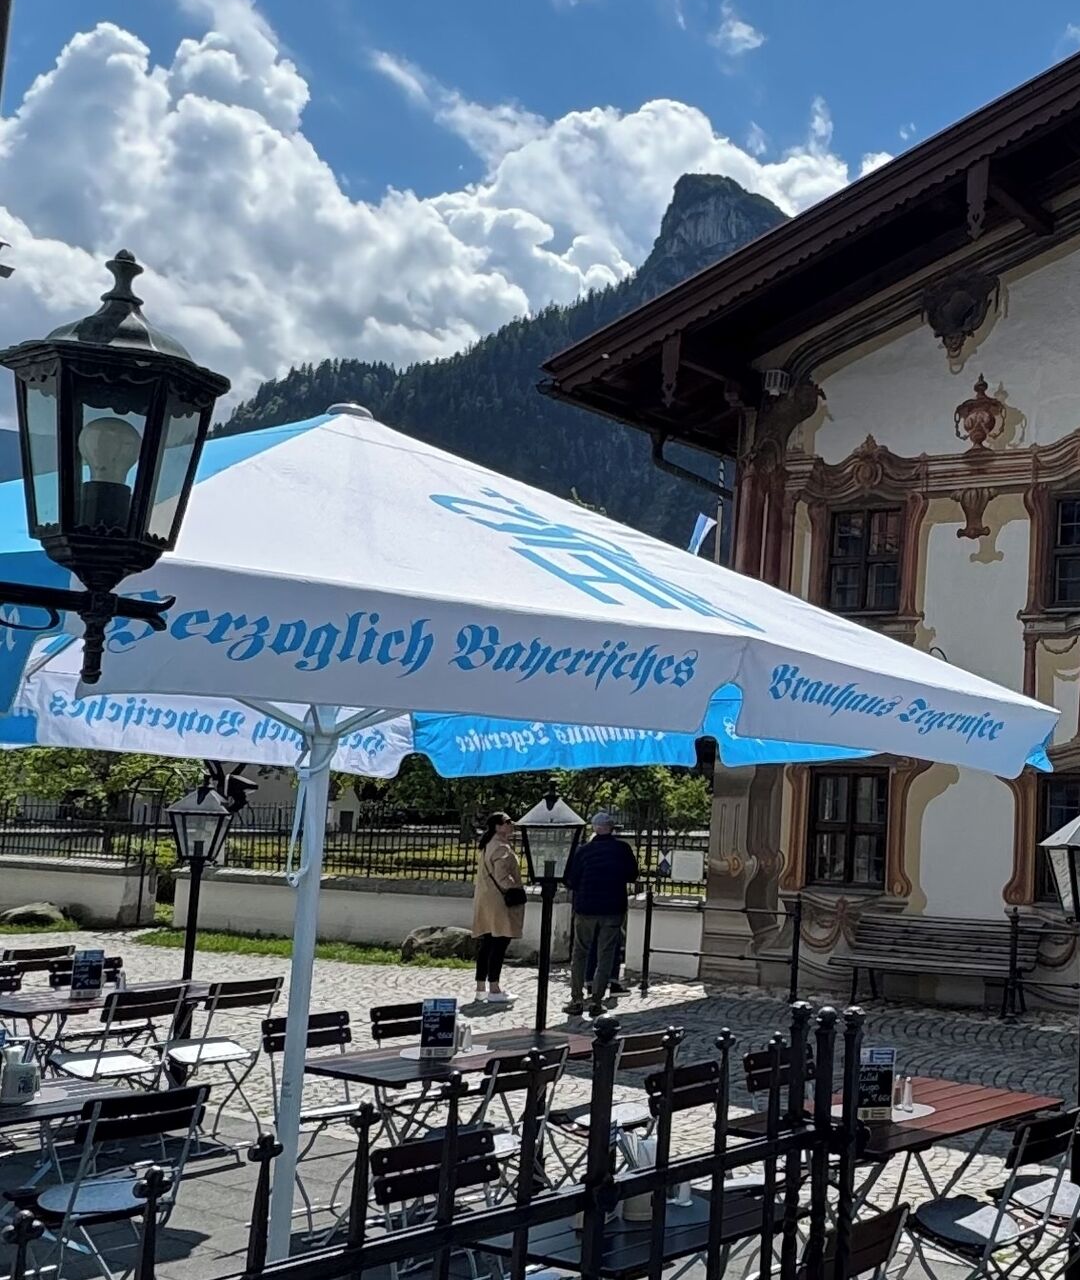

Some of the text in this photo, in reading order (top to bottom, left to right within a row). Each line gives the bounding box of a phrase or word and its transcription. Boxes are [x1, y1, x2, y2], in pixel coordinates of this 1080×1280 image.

[448, 624, 699, 695] Bayerisches
[767, 664, 1005, 744] Brauhaus Tegernsee
